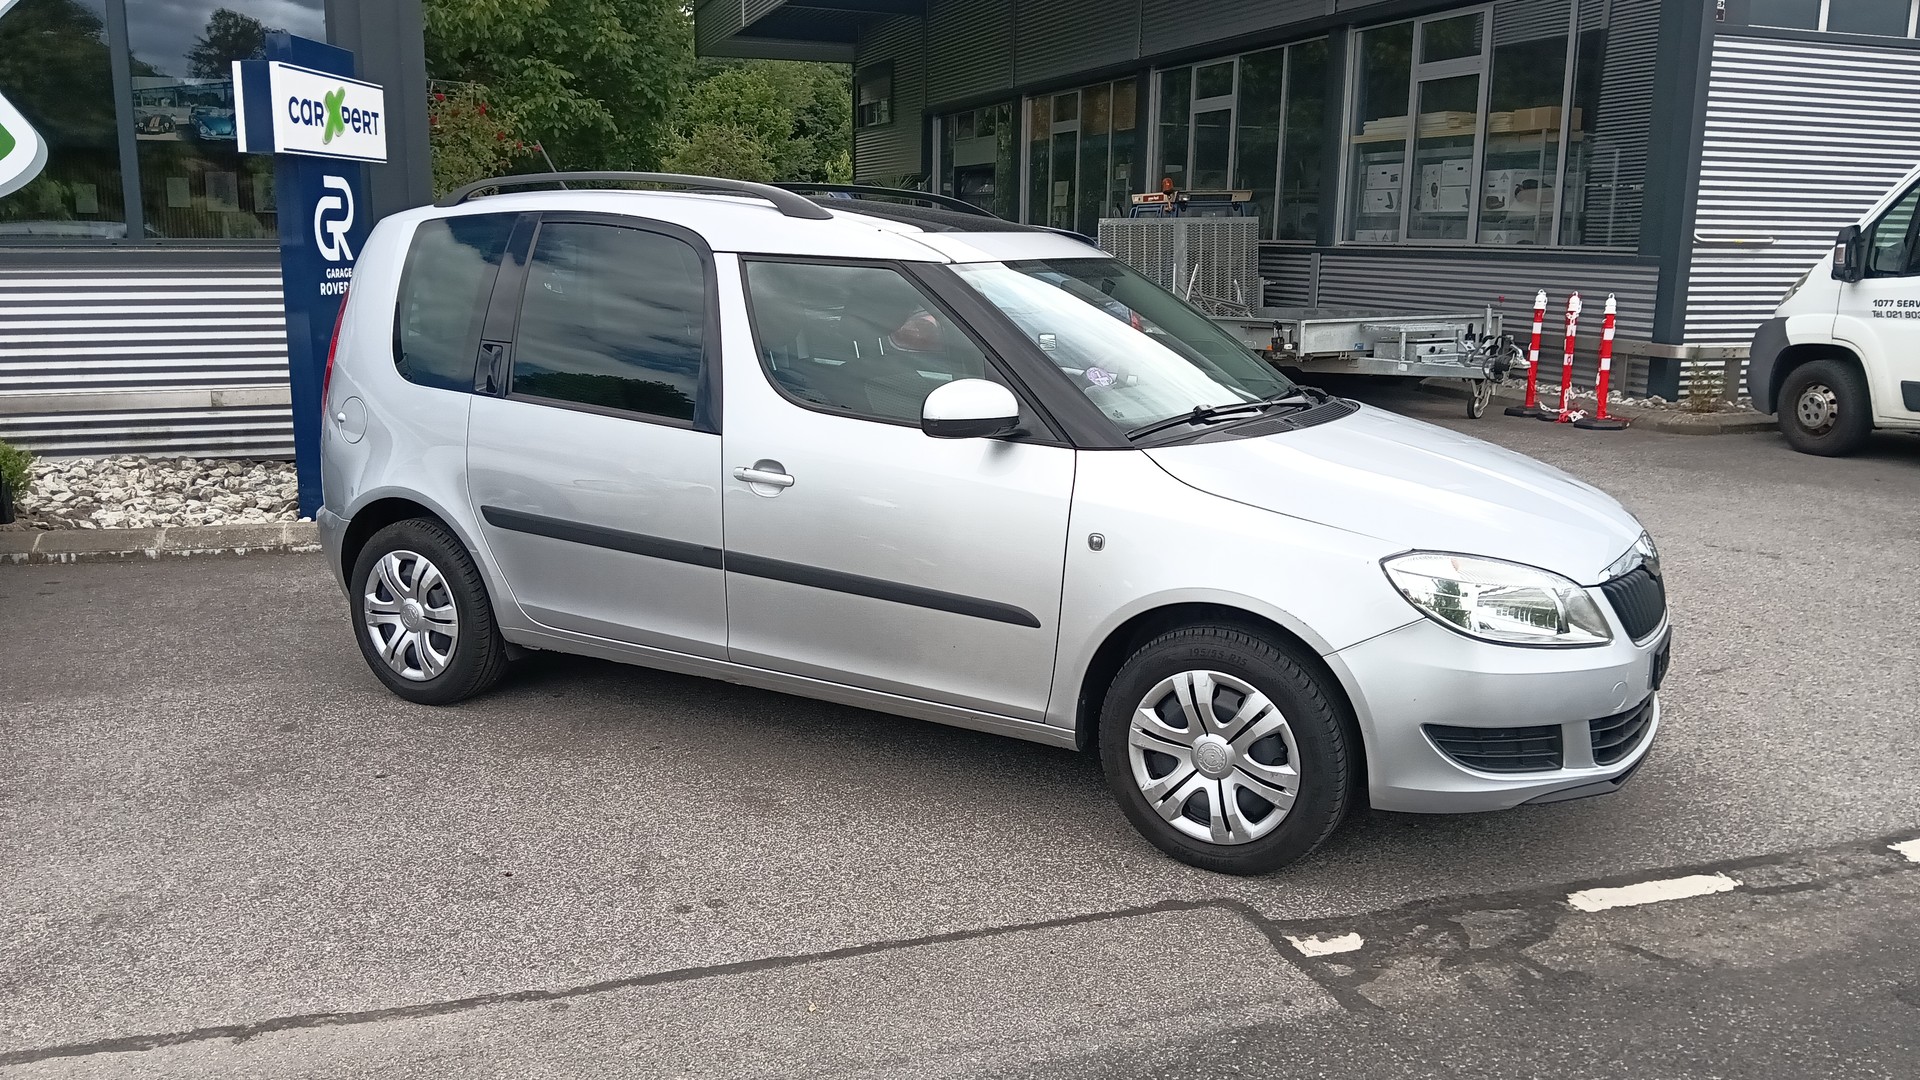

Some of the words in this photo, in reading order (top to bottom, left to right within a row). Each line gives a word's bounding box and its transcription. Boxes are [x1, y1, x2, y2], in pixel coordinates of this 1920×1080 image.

[326, 267, 353, 279] GARAGE
[1873, 299, 1894, 307] 1077
[1886, 310, 1902, 318] 021
